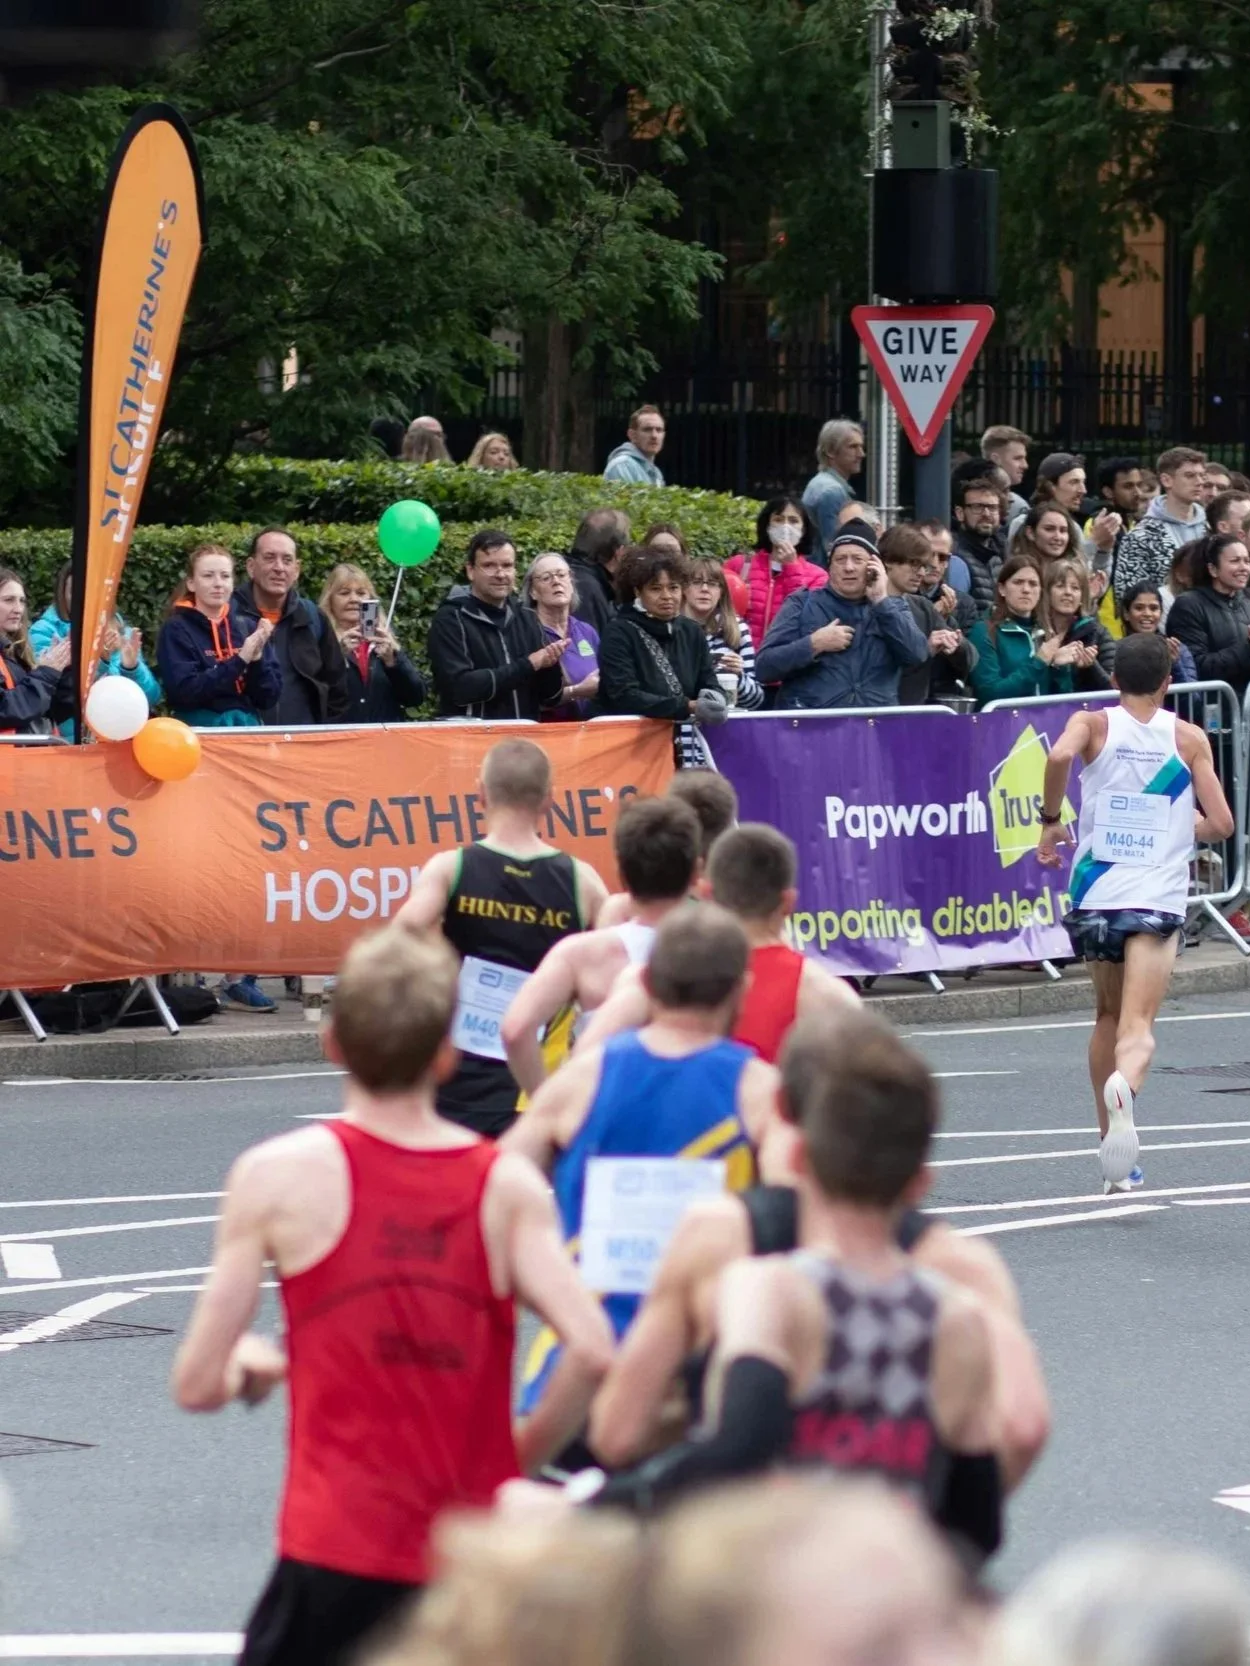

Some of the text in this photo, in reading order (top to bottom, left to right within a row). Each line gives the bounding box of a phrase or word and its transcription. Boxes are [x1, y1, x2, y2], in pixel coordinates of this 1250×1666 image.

[109, 199, 178, 476] CATHERINE'S
[882, 327, 958, 355] GIVE
[900, 364, 947, 383] WAY
[325, 785, 638, 849] CATHENE'
[825, 788, 1047, 850] Papworth Trus
[1105, 832, 1154, 849] M40-44
[1112, 848, 1123, 857] DE
[265, 866, 422, 923] HOSP
[458, 896, 571, 930] HUNTS AC
[932, 886, 1054, 936] disabled
